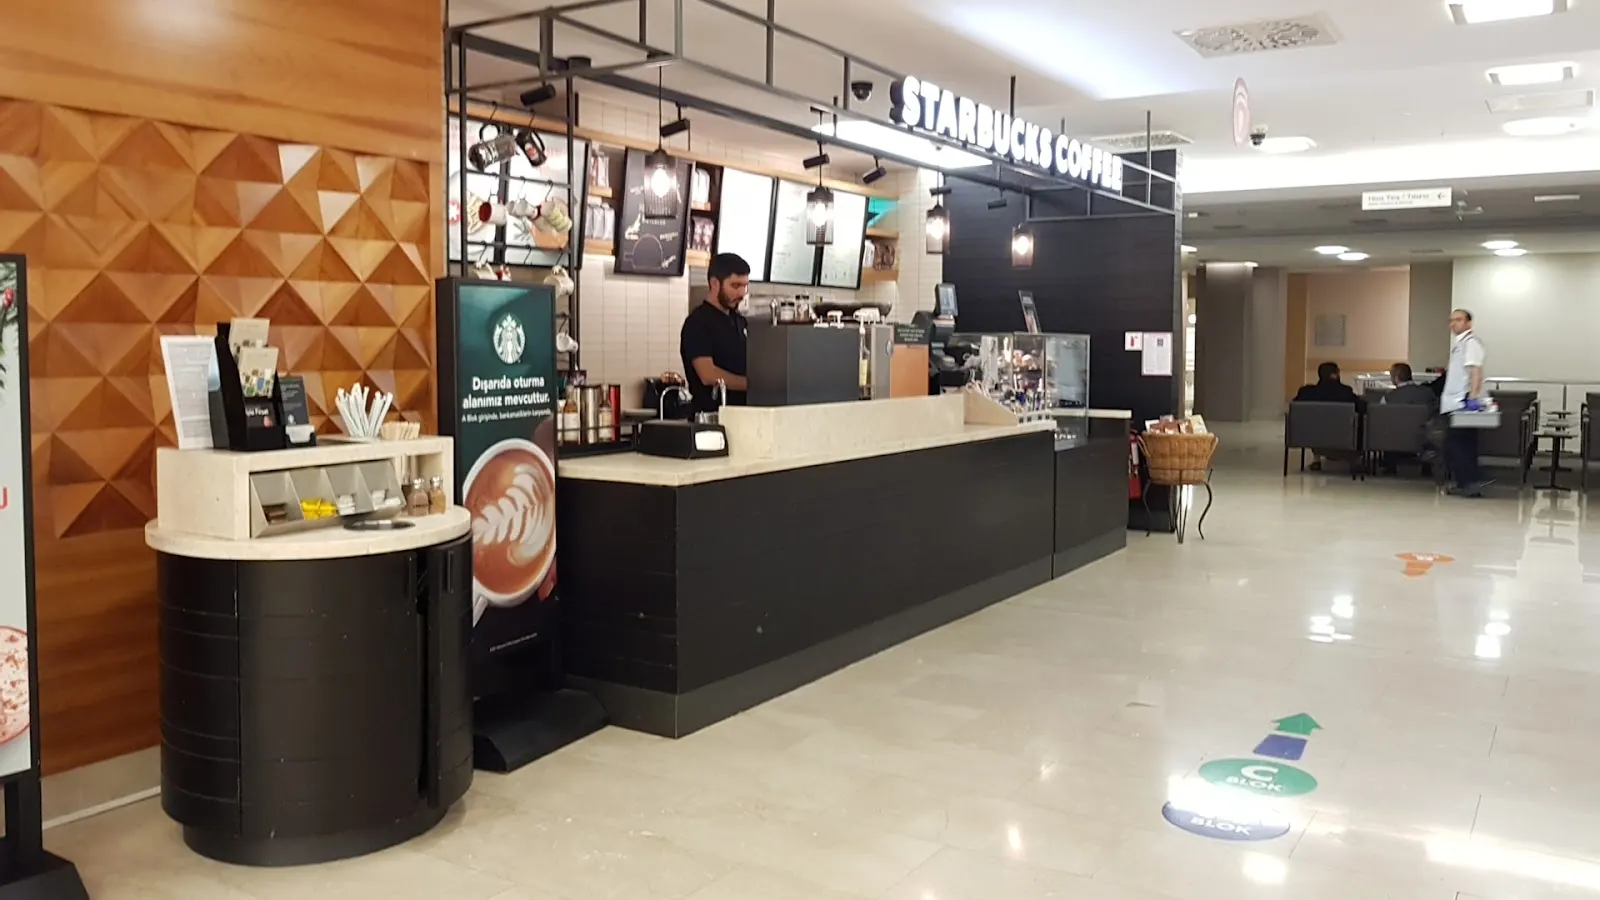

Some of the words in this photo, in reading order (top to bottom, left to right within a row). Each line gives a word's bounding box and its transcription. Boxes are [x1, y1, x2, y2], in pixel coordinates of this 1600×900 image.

[901, 75, 1053, 169] STARBUCKS
[1055, 133, 1123, 192] COFFEE
[472, 375, 511, 393] Dışarıda
[513, 376, 545, 389] oturma
[462, 394, 502, 409] alanımız
[504, 392, 550, 406] mevcuttur.
[1240, 764, 1280, 782] C
[1225, 775, 1283, 792] BLOK
[1190, 816, 1251, 835] BLOK
